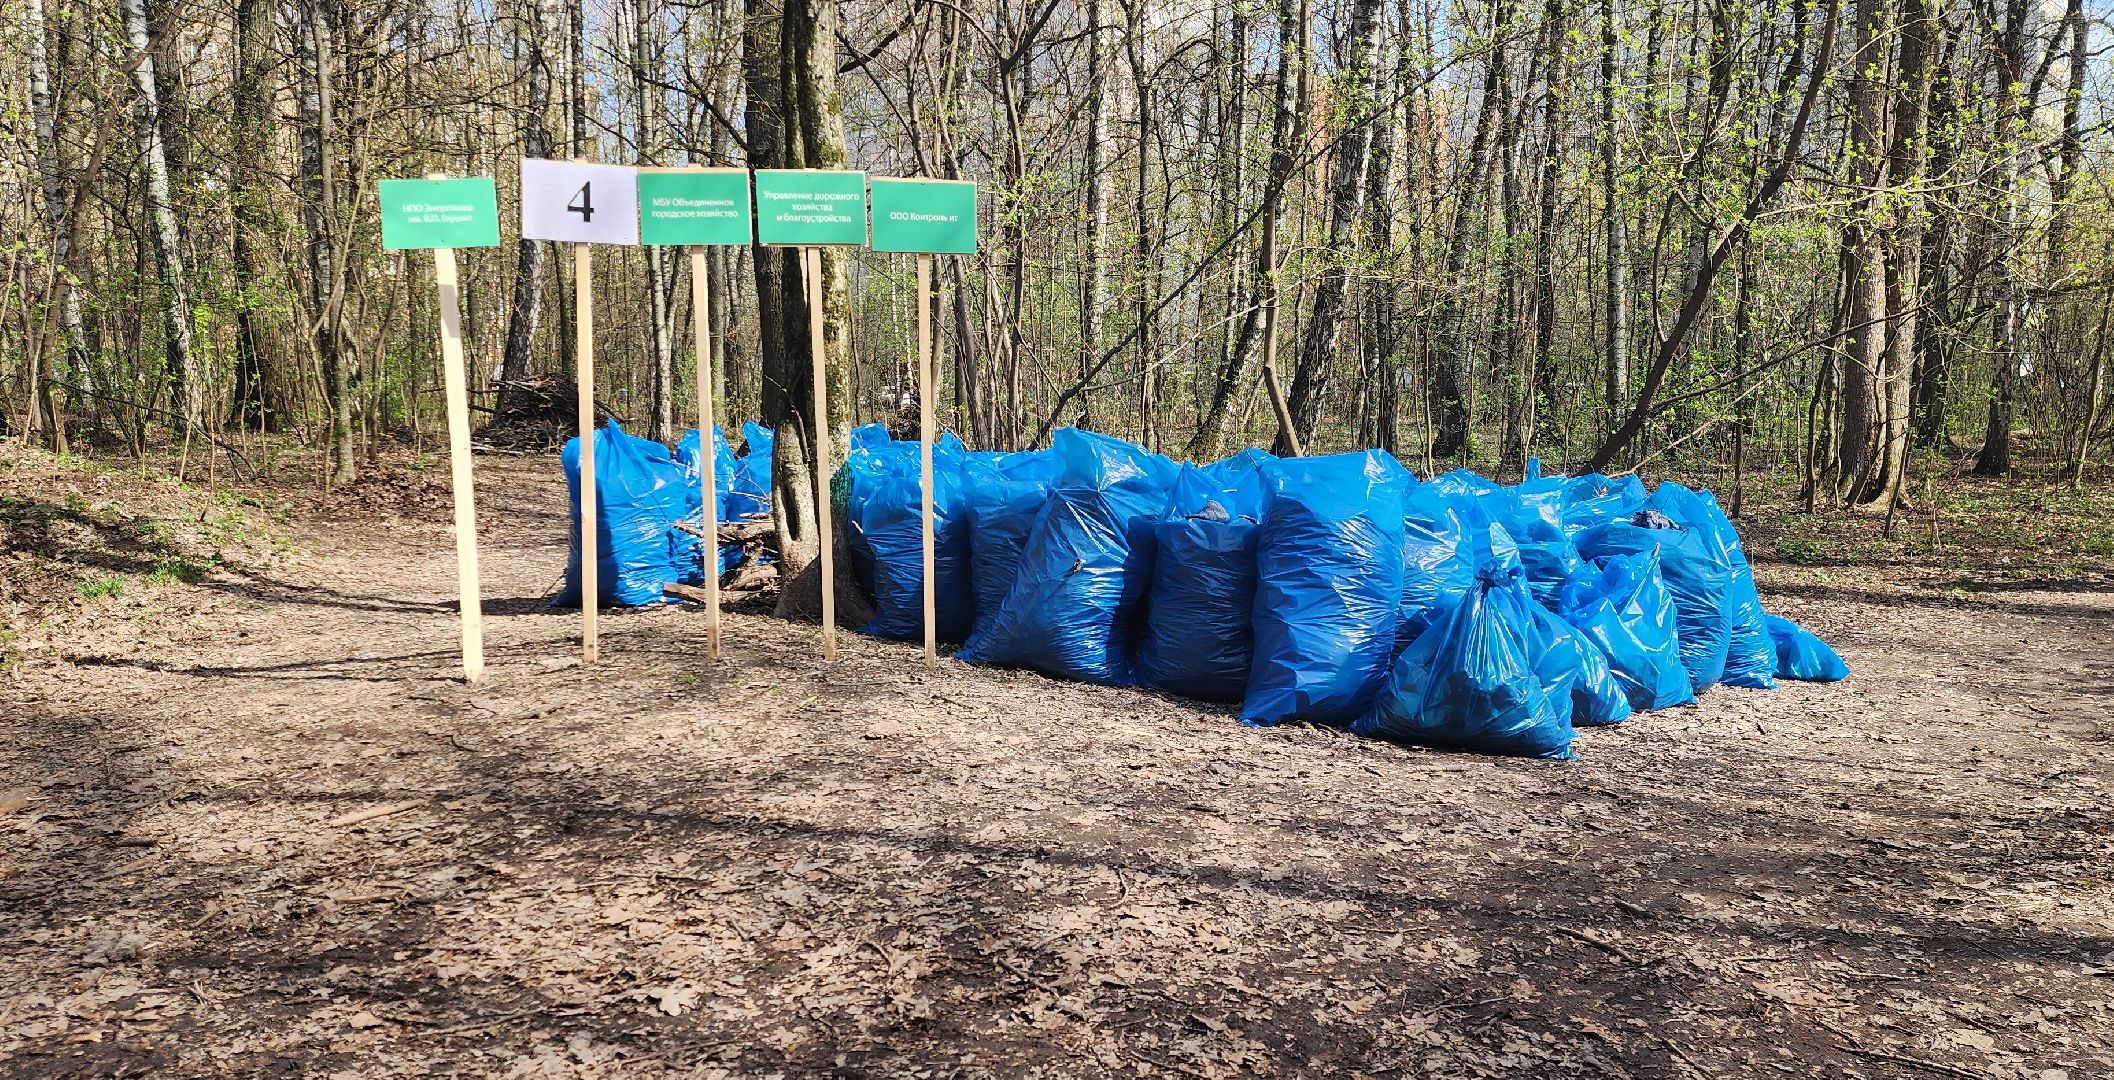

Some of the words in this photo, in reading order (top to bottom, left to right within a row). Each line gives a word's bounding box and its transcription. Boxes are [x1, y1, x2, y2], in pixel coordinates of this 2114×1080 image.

[763, 190, 812, 200] Управление
[814, 192, 860, 201] дорожного
[567, 181, 594, 222] 4
[652, 197, 670, 206] МБУ
[672, 198, 735, 207] Объединенное
[791, 202, 833, 212] хозяйства
[651, 210, 695, 219] городское
[696, 208, 739, 218] хозяйство
[776, 214, 783, 222] и
[783, 213, 852, 223] благоустройства
[889, 211, 909, 221] ООО
[910, 212, 948, 223] Контроль
